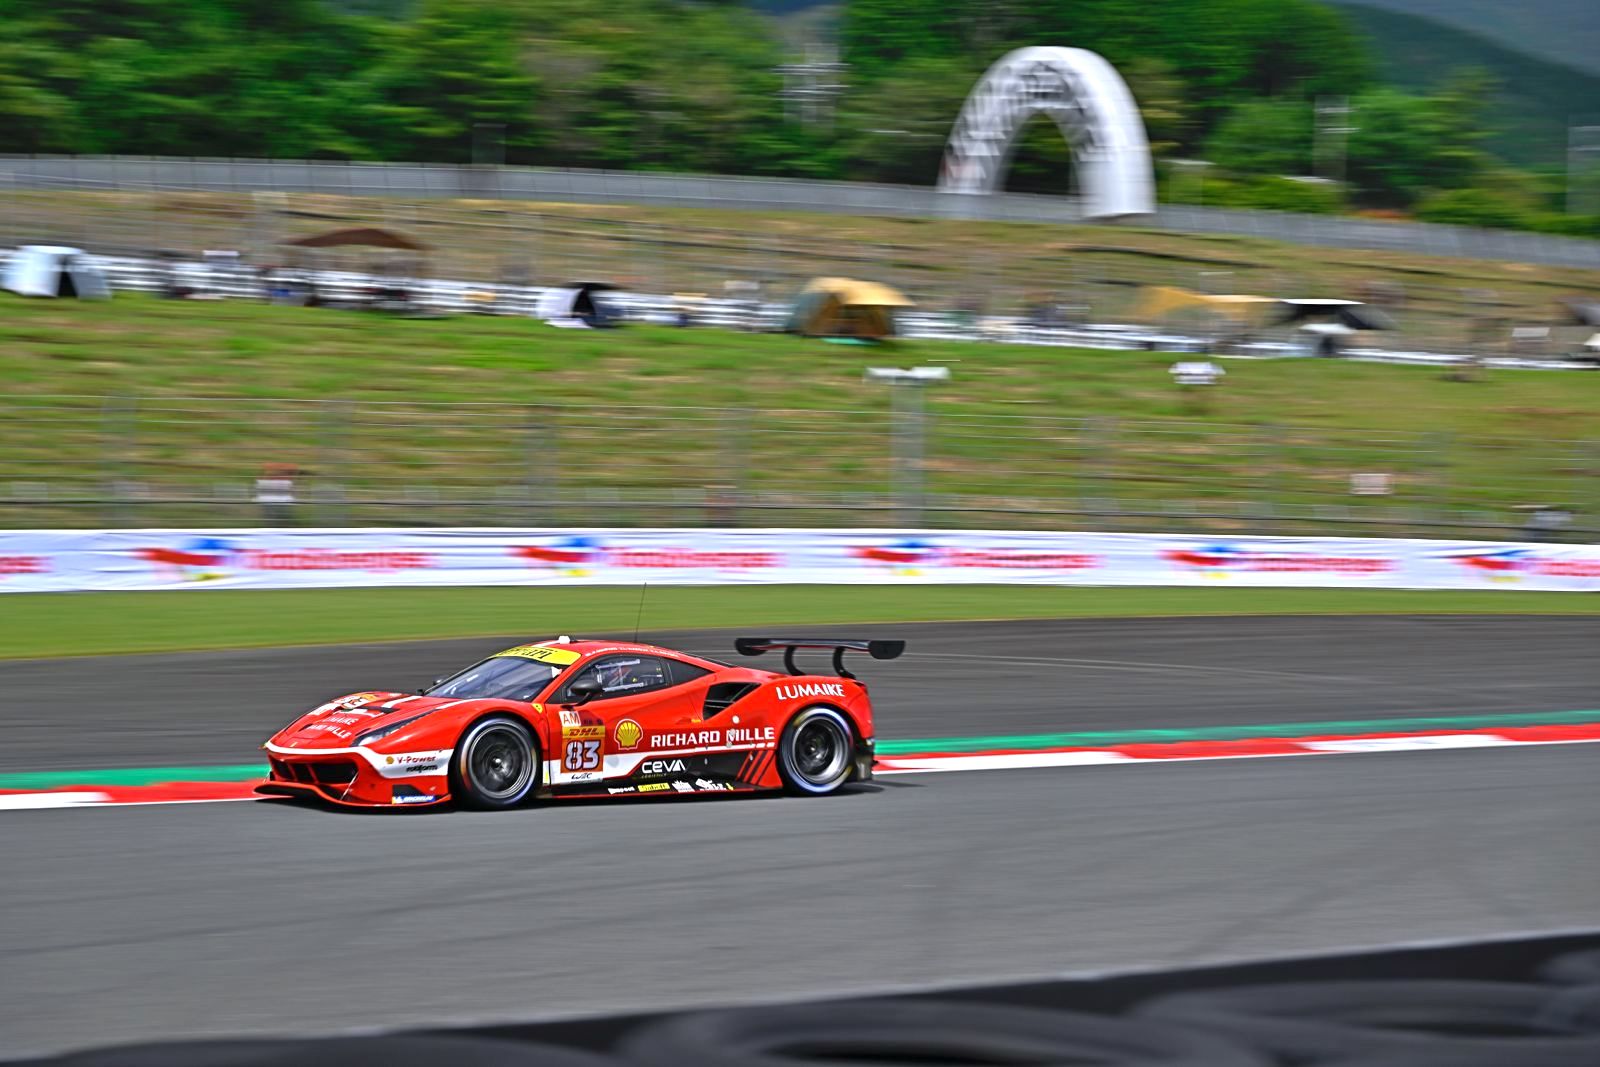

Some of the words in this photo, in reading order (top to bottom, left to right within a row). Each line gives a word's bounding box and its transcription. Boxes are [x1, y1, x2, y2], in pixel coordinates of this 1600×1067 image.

[775, 683, 845, 700] LUMAIKE
[562, 712, 581, 725] AM
[568, 728, 600, 737] DHL
[651, 731, 720, 748] RICHARD
[726, 727, 775, 743] MILLE
[396, 756, 436, 764] V-Power
[565, 740, 601, 771] 83
